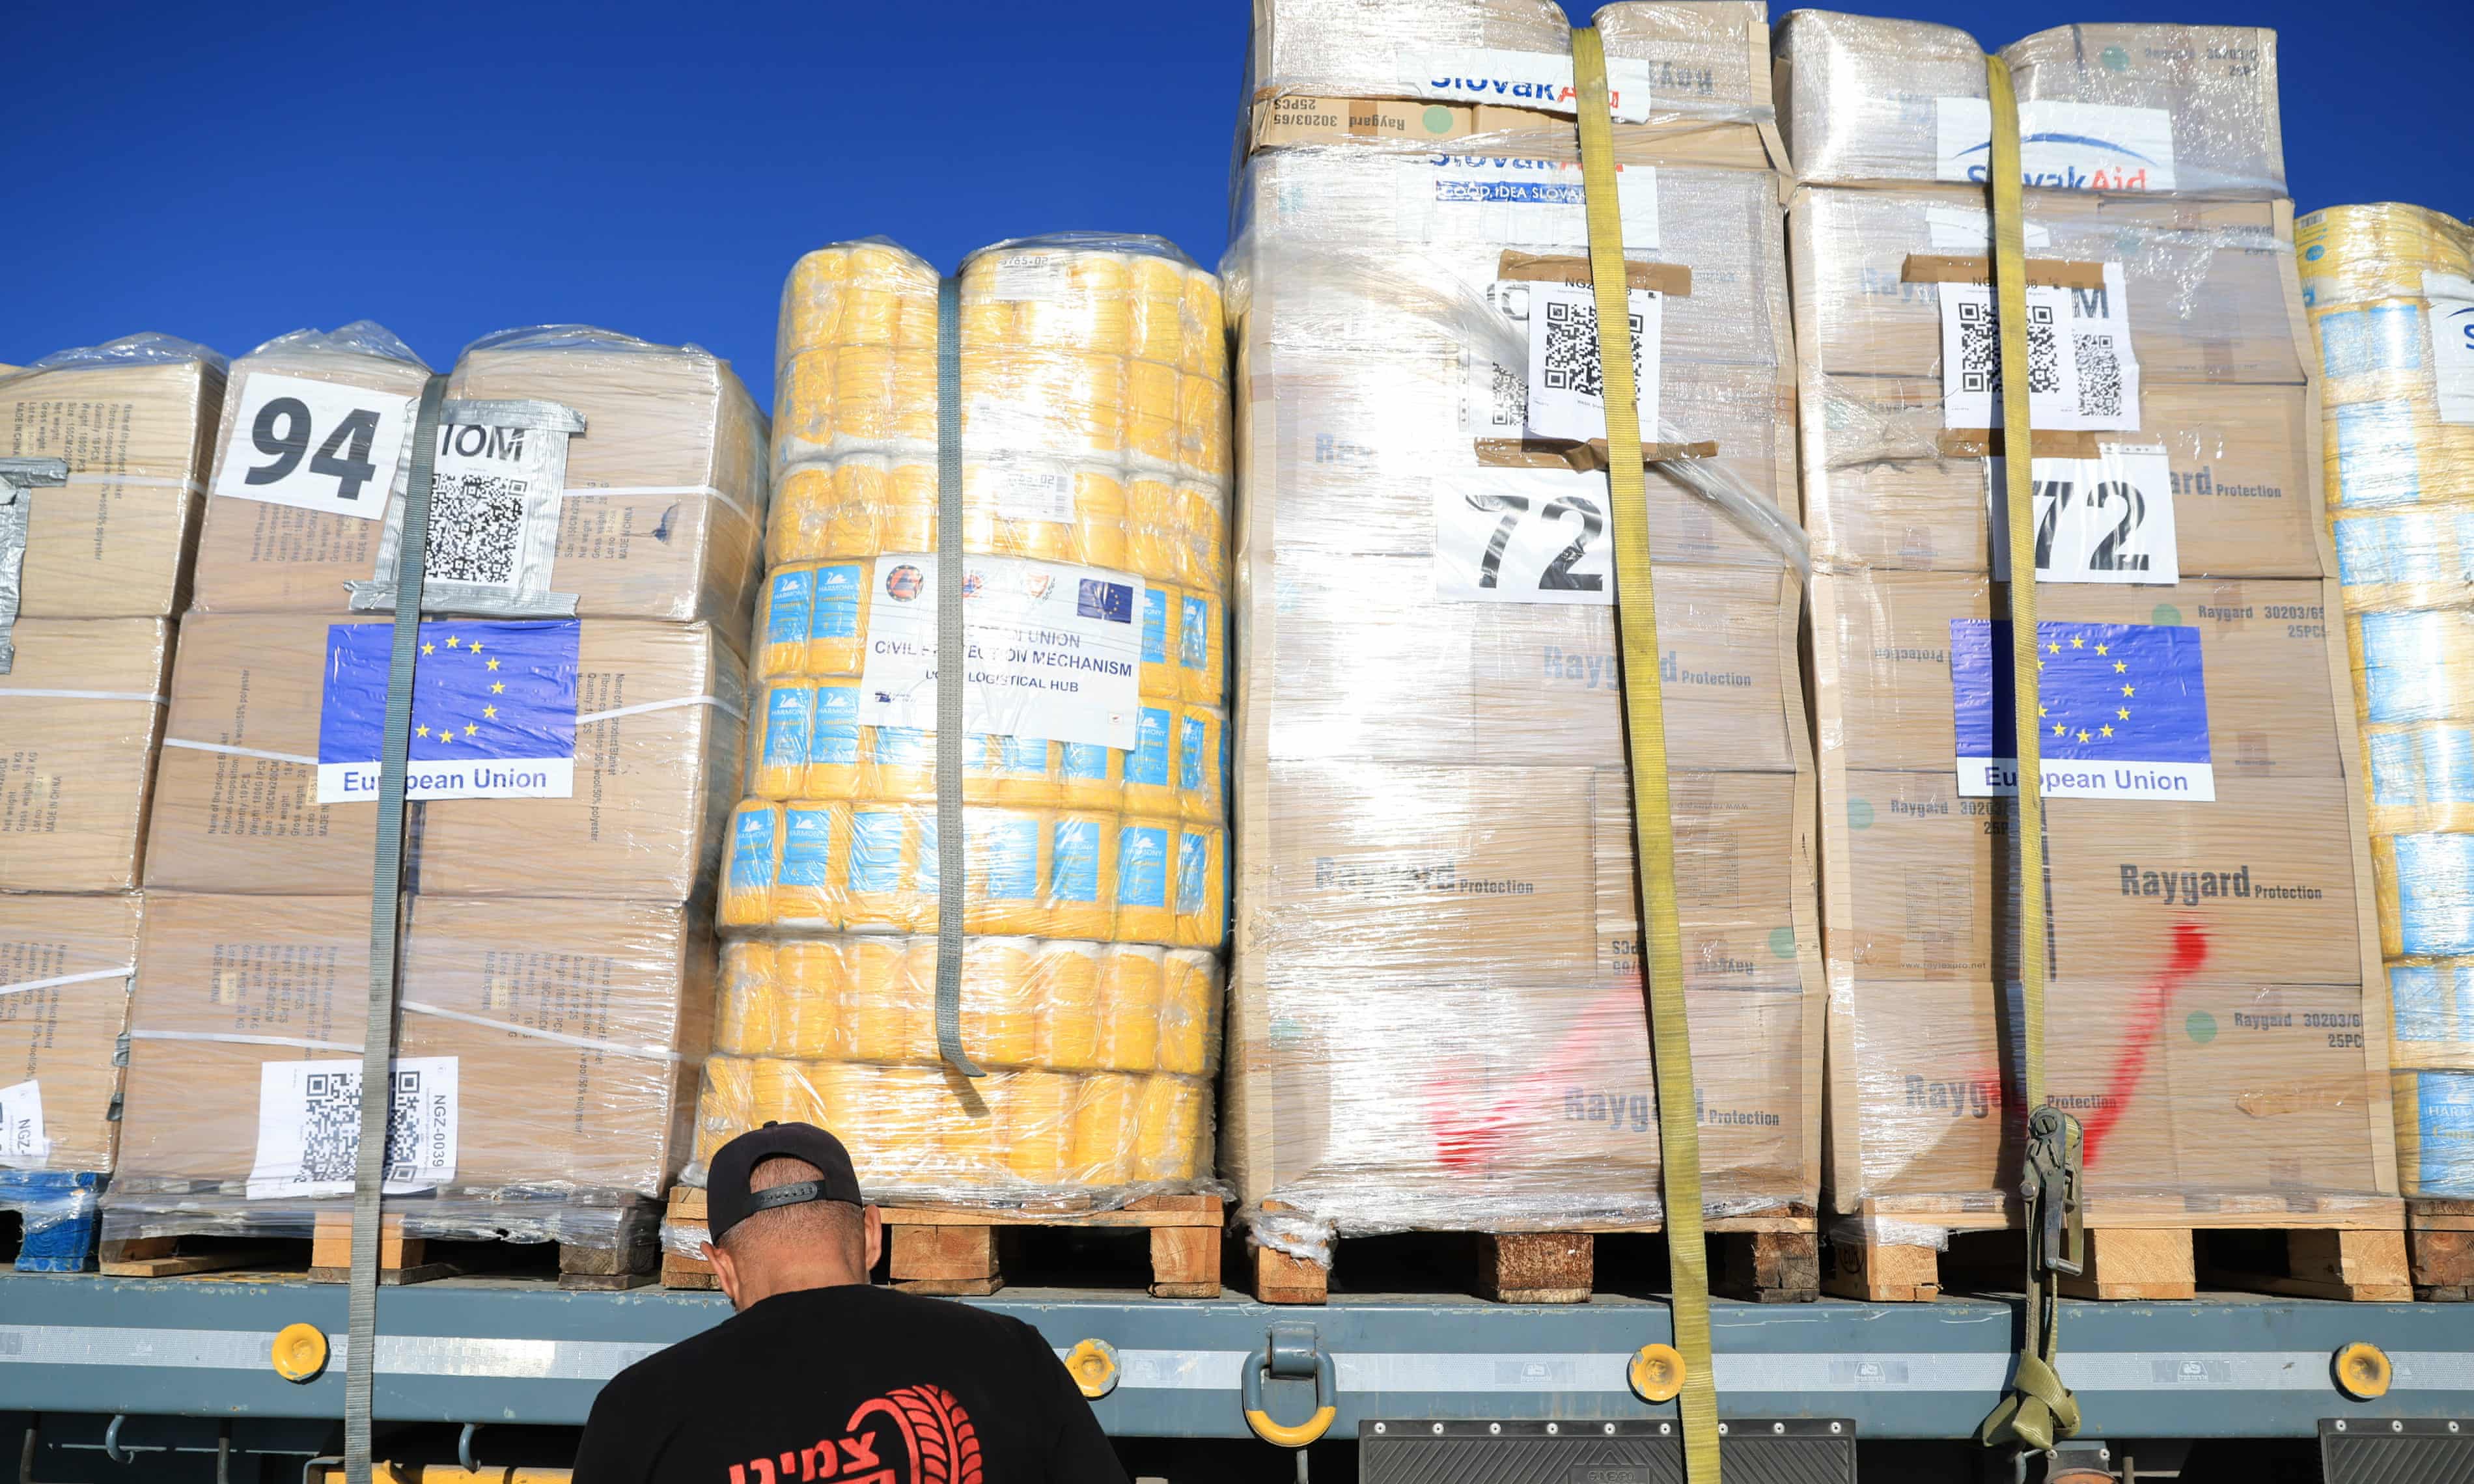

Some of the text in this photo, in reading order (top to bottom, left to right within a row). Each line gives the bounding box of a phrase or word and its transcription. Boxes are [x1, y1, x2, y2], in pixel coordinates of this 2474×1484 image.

[1273, 98, 1316, 111] 25PCS
[1273, 113, 1406, 131] Raygard 30203/65
[244, 396, 382, 502] 94
[441, 424, 523, 463] IOM
[2216, 484, 2282, 497] Protection
[2032, 480, 2150, 571] 72
[1466, 495, 1603, 591] 72
[2197, 604, 2253, 622] Raygard
[1028, 631, 1080, 648] UNION
[1032, 651, 1132, 678] MECHANISM
[1049, 680, 1079, 693] HUB
[1682, 670, 1751, 687] Protection
[344, 768, 547, 794] Eupean Union
[1985, 767, 2189, 792] Eupean Union
[1891, 799, 1949, 818] Raygard
[1460, 879, 1534, 895] Protection
[2120, 864, 2322, 906] Raygard Protection
[2234, 1012, 2361, 1030] Raygard 30203/6
[2328, 1034, 2362, 1049] 25PC
[2047, 1094, 2117, 1110] Protection
[1710, 1109, 1780, 1127] Protection
[432, 1094, 447, 1167] NGZ-0039
